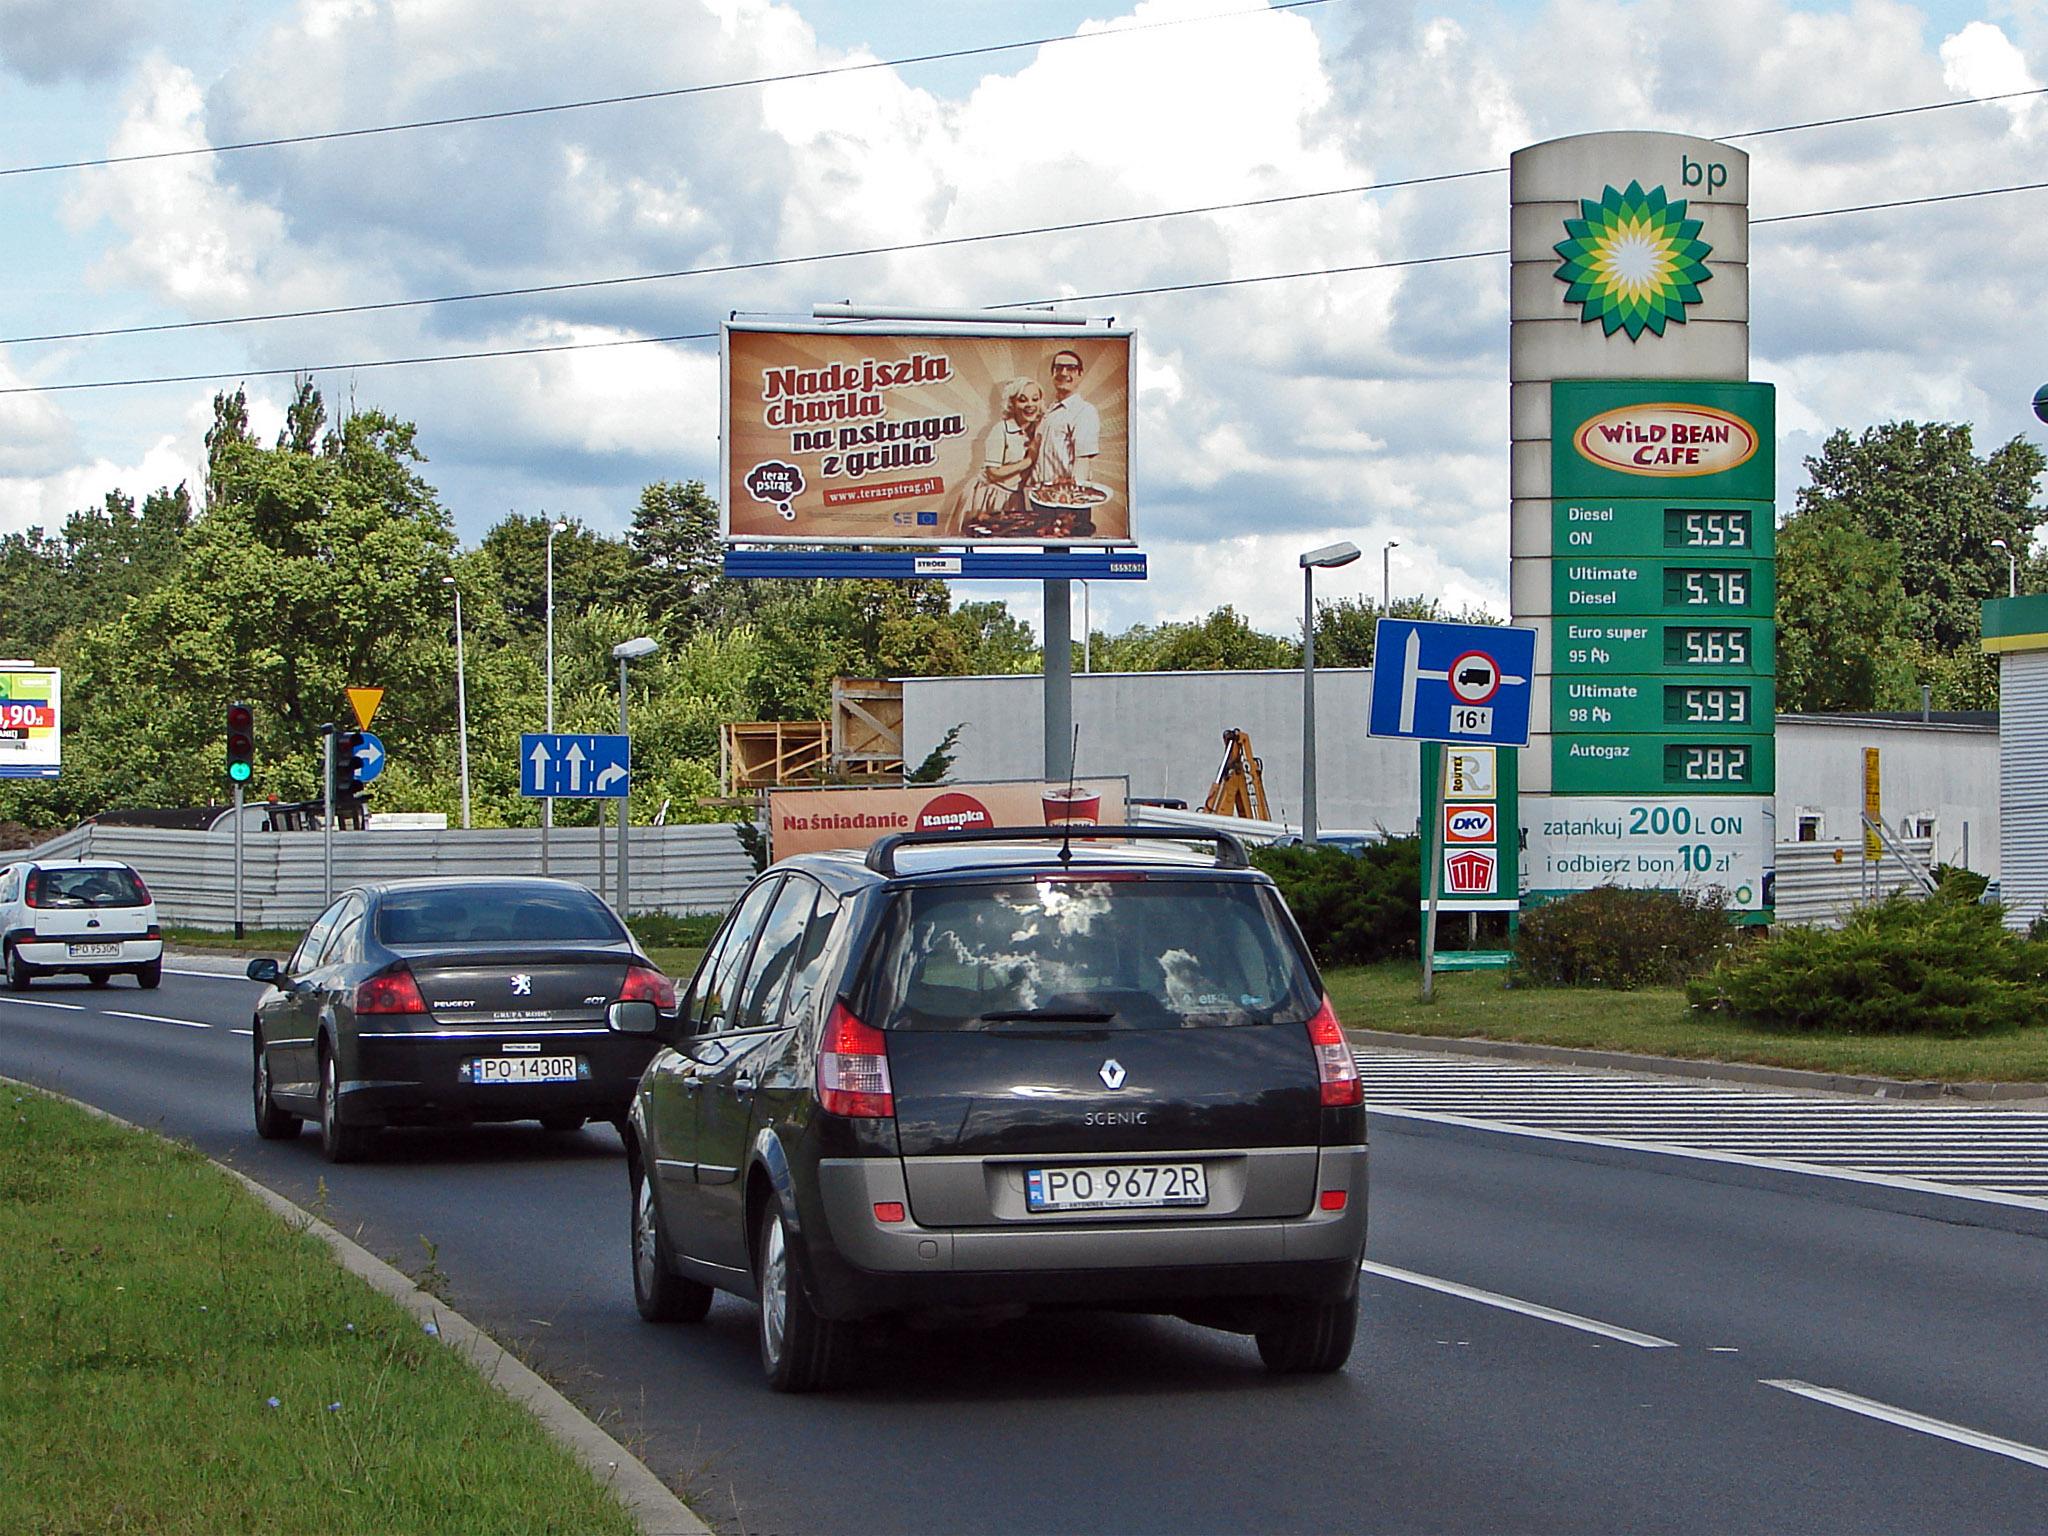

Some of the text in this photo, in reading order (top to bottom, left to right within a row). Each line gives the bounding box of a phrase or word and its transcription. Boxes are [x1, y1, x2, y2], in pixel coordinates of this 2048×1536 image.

[1682, 154, 1728, 196] bp
[765, 355, 950, 398] Nadejszła
[766, 392, 883, 426] chwila
[793, 430, 835, 451] na
[1671, 423, 1730, 445] BEAN
[1632, 445, 1700, 465] CAFE
[822, 456, 842, 476] z
[761, 471, 790, 482] teraz
[755, 480, 794, 494] pstrąg
[829, 479, 936, 503] www.terazpstrag.pl
[1568, 507, 1614, 521] Diesel
[1568, 532, 1593, 545] ON
[1686, 514, 1746, 546] 5.55
[1568, 567, 1638, 580] Ultimate
[1568, 590, 1617, 604] Diesel
[1686, 573, 1745, 605] 5.76
[1568, 626, 1648, 642] Euro super
[1568, 650, 1587, 663] 95
[1686, 632, 1745, 663] 5.65
[1568, 684, 1638, 698] Ultimate
[1568, 709, 1588, 722] 98
[1686, 690, 1745, 722] 5.93
[1456, 710, 1478, 729] 16
[1569, 743, 1630, 759] Autogaz
[1686, 749, 1745, 780] 2.82
[783, 811, 909, 831] Na śniadanie
[923, 810, 985, 827] Kanapka
[1452, 817, 1489, 830] DKV
[1543, 806, 1743, 840] zatankuj 200 L ON
[1547, 844, 1730, 873] i odbierz bon 10 zł
[1451, 854, 1491, 889] UTA
[484, 1058, 574, 1078] PO 1430R
[1084, 1111, 1148, 1126] SCENIC
[1047, 1166, 1201, 1201] PO 9672R
